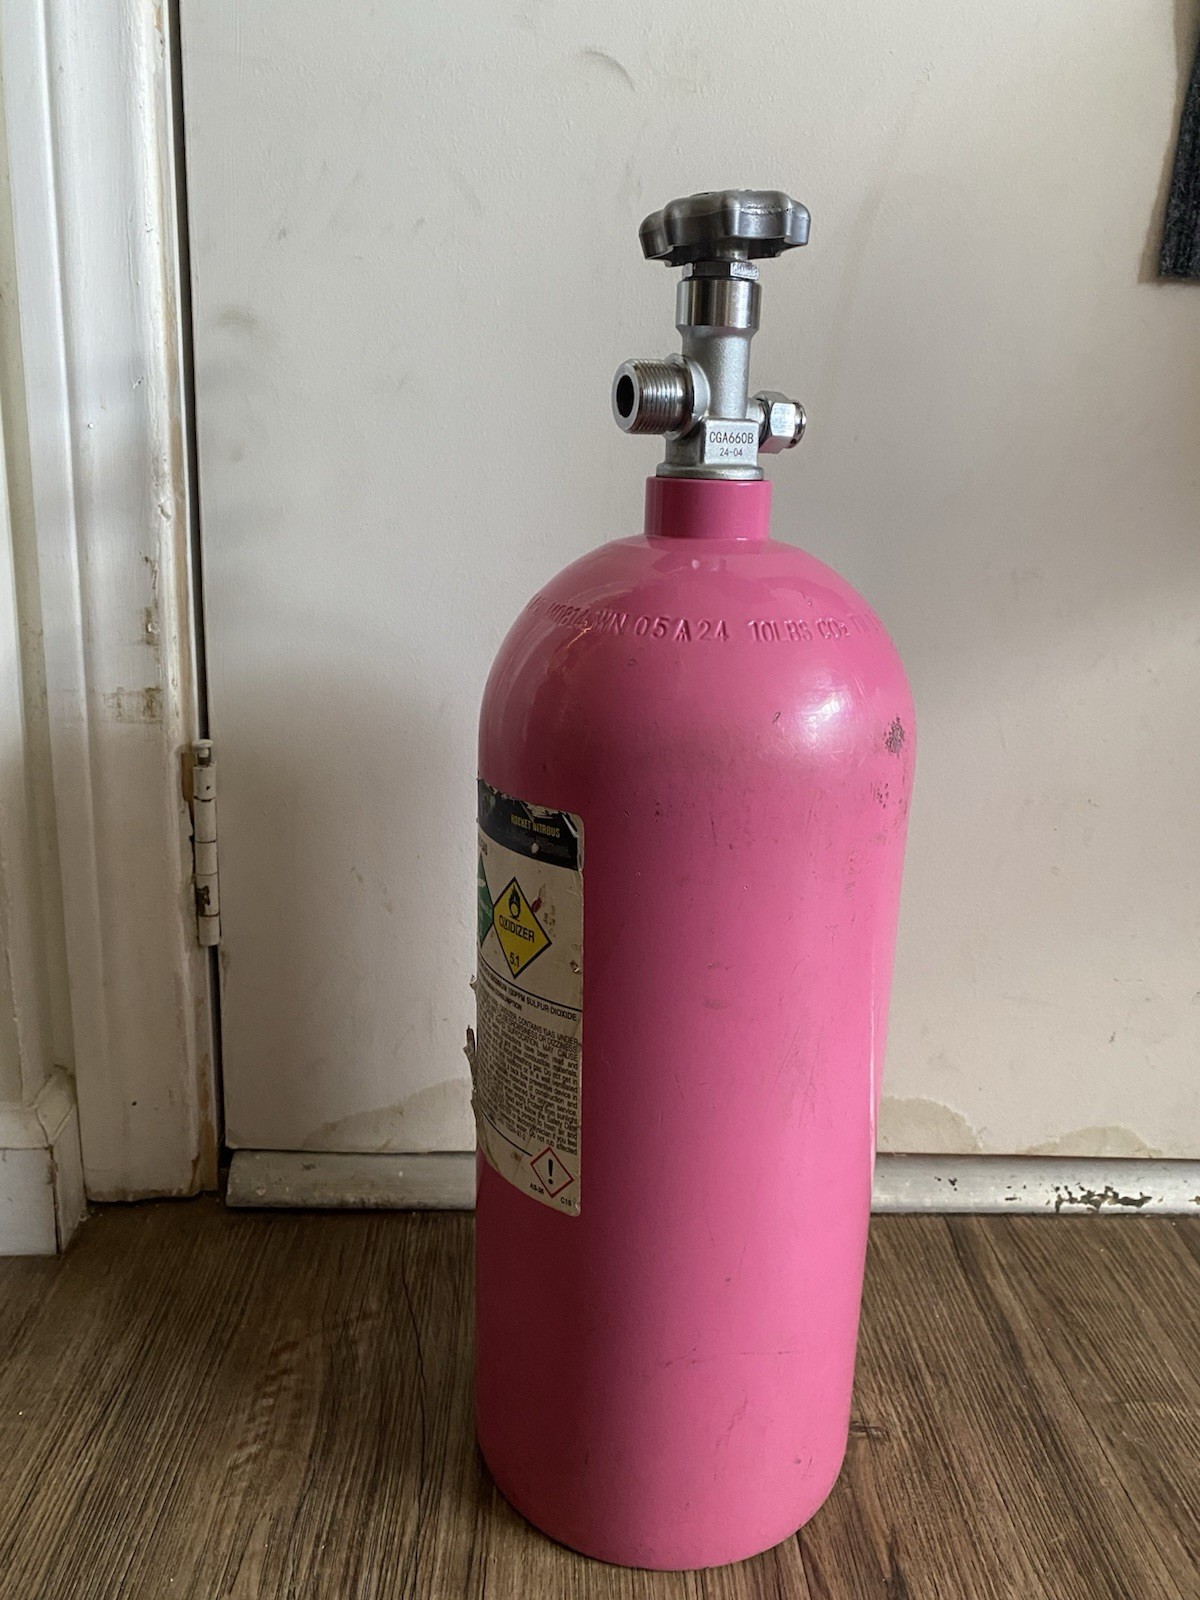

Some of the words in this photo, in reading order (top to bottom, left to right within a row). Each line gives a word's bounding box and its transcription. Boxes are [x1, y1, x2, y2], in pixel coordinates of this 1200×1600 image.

[709, 431, 754, 444] CGA660B
[719, 447, 743, 457] 24-04
[499, 915, 535, 943] OXIDIZER
